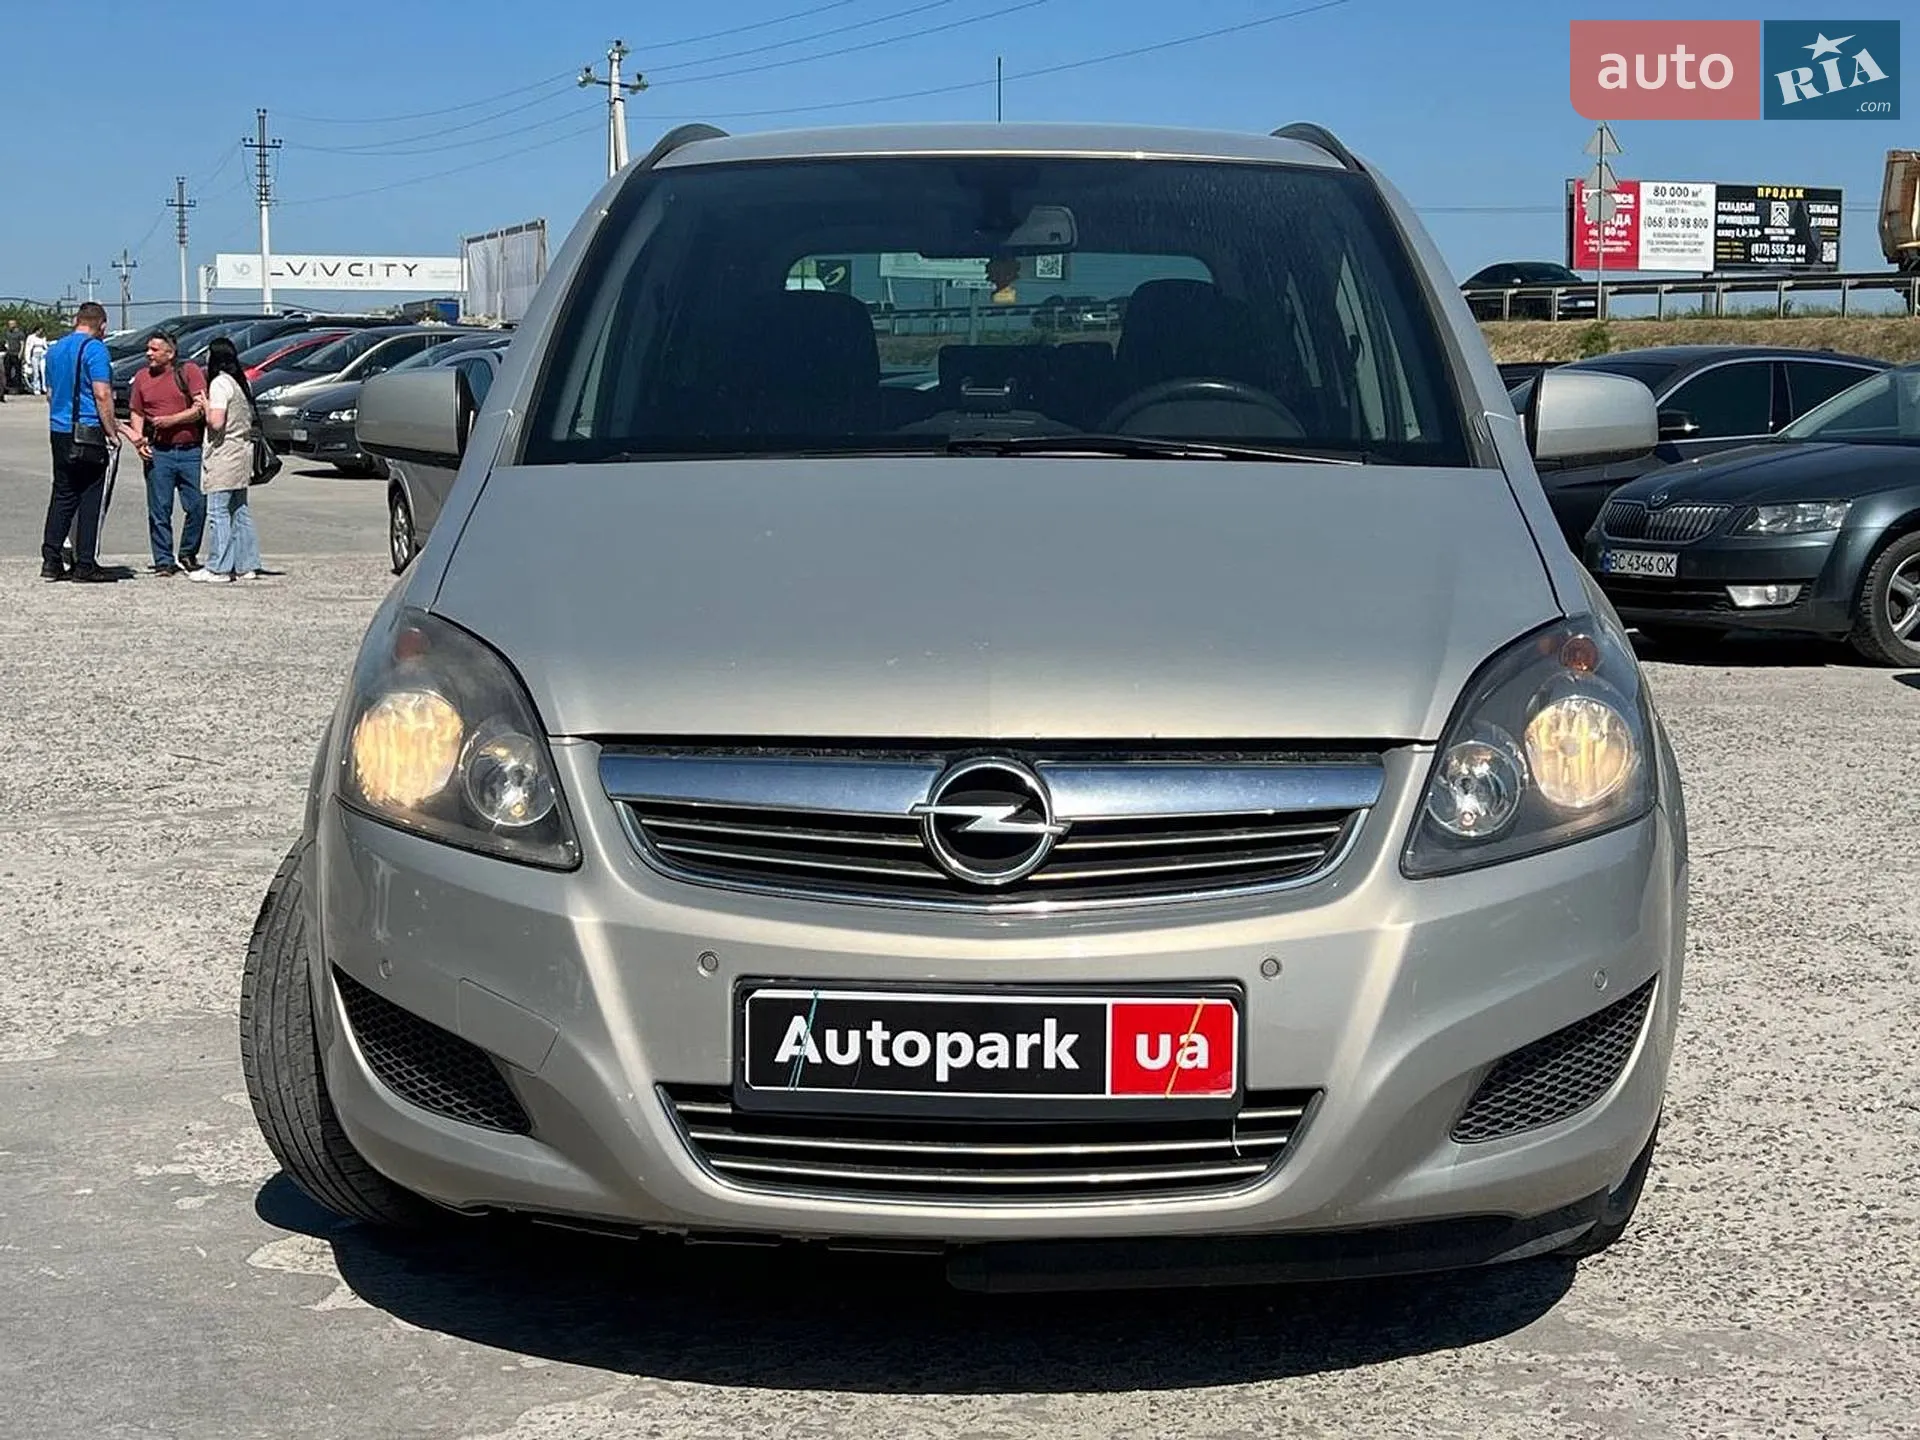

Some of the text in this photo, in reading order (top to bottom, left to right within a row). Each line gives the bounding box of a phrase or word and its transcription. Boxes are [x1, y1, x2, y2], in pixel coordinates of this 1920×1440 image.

[1653, 186, 1667, 197] 80
[1669, 186, 1689, 197] 000
[1757, 187, 1804, 199] ПРОДАЖ
[1656, 556, 1674, 575] OK
[774, 1014, 1209, 1083] Autopark ua
